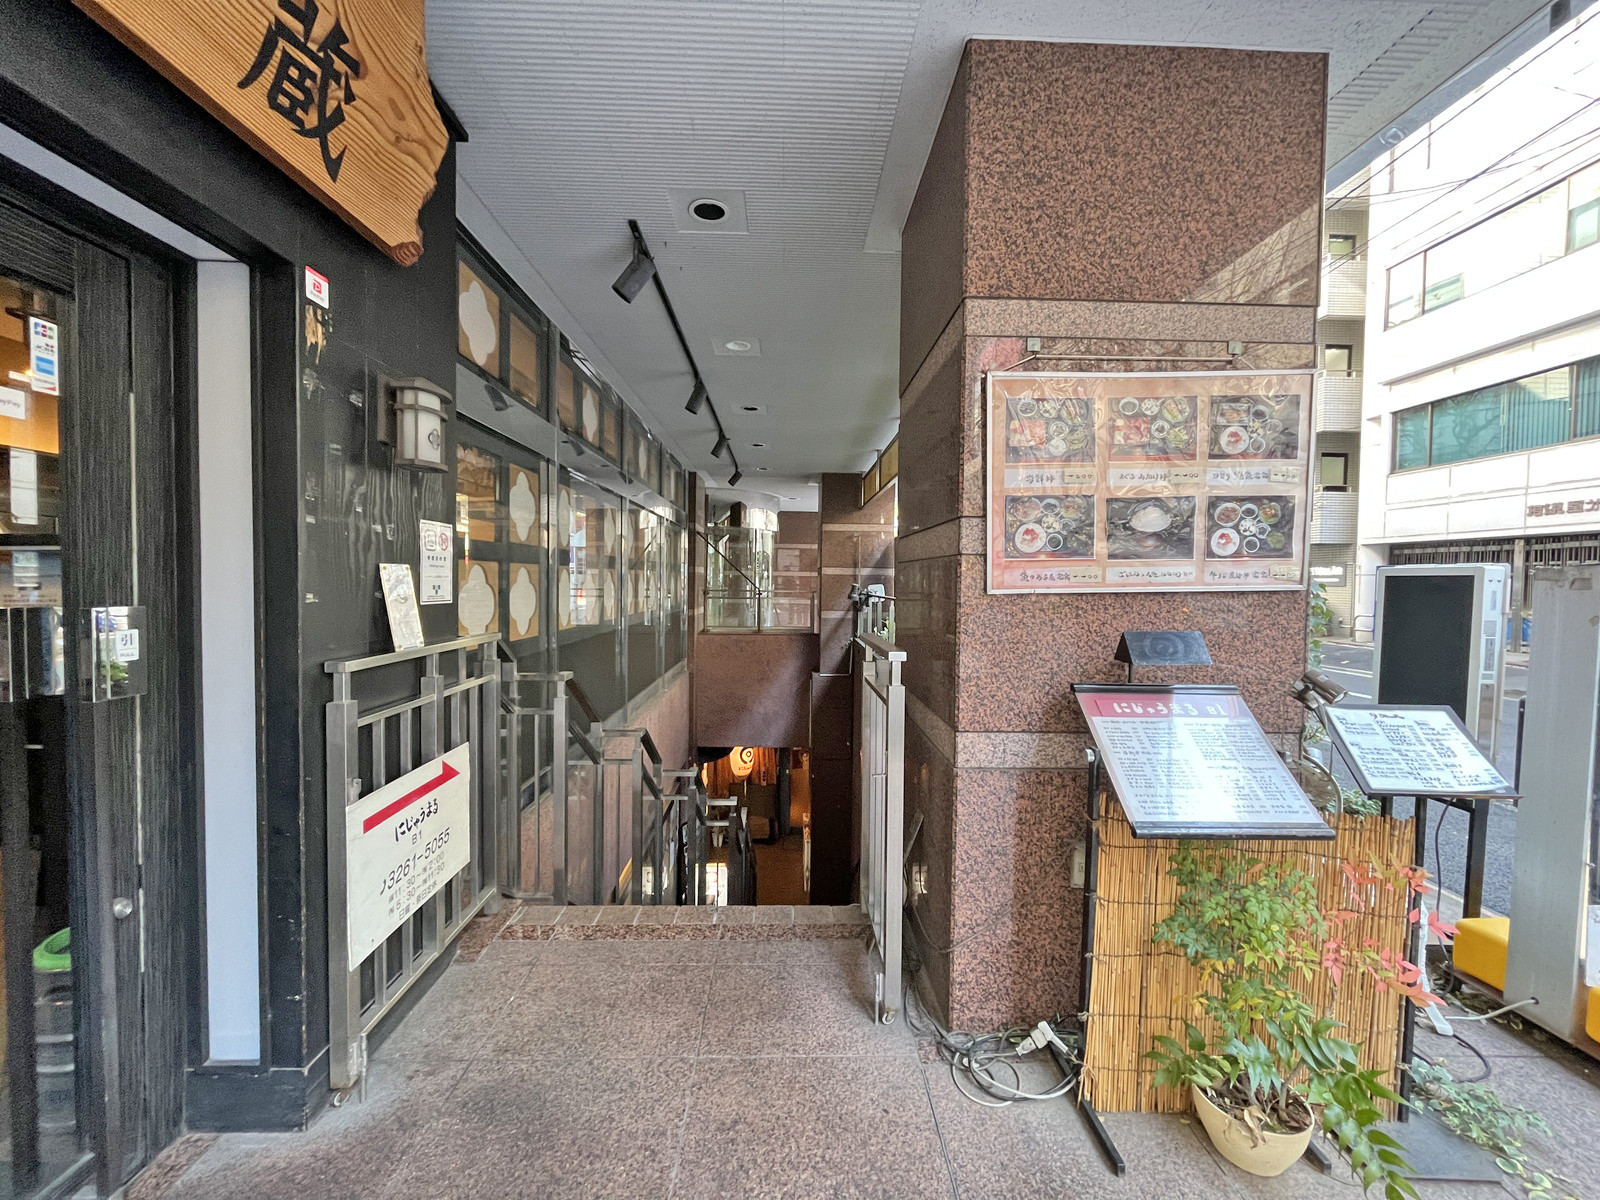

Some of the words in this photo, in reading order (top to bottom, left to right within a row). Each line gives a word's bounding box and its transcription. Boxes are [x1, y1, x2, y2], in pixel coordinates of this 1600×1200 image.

[1112, 702, 1199, 716] にじゅうまる
[1205, 703, 1228, 716] B1
[394, 798, 439, 842] にじゅうまる
[411, 832, 423, 846] B1
[387, 827, 451, 891] 3261-5055
